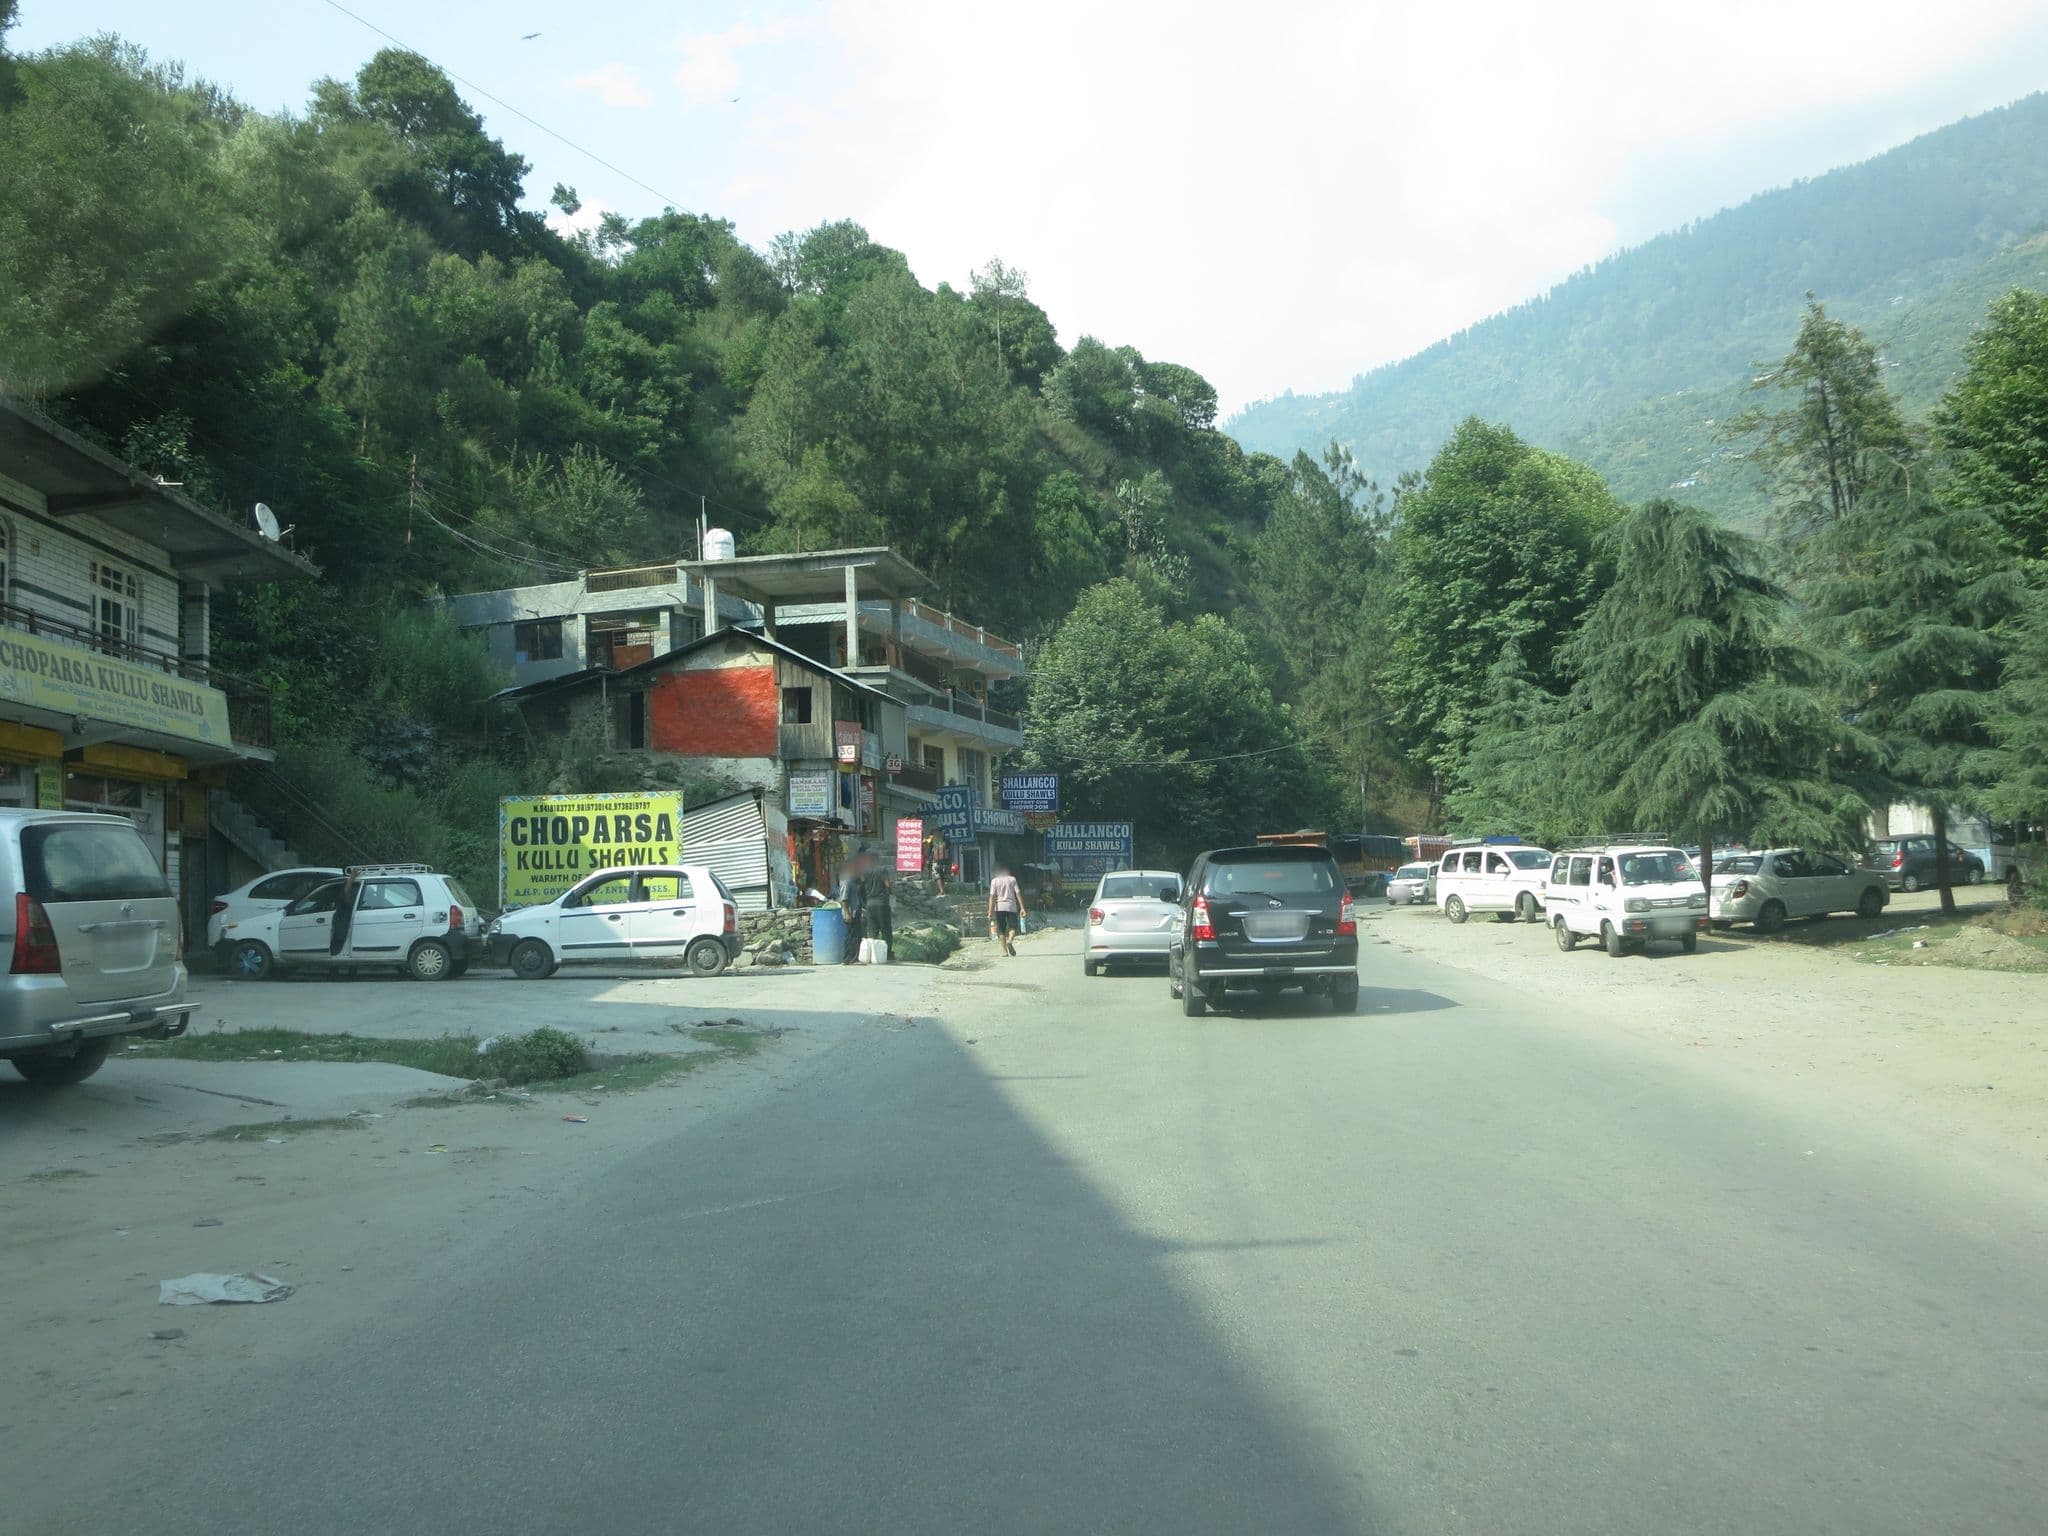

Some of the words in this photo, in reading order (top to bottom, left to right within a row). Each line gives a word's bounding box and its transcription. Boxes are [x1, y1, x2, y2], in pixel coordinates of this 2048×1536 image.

[0, 640, 95, 688] CHOPARSA
[97, 666, 148, 701] KULLU
[151, 682, 204, 716] SHAWLS
[840, 747, 853, 755] 3G
[1003, 777, 1055, 789] SHALLANGCO
[1025, 790, 1054, 799] SHAWLS
[511, 813, 673, 846] CHOPARSA
[1047, 824, 1129, 838] SHALLANGCO
[1057, 840, 1083, 850] KULLU
[1085, 840, 1121, 850] SHAWLS
[517, 849, 579, 871] KULLU
[589, 846, 668, 869] SHAWLS
[531, 874, 568, 883] WARMTH
[572, 874, 583, 882] OF
